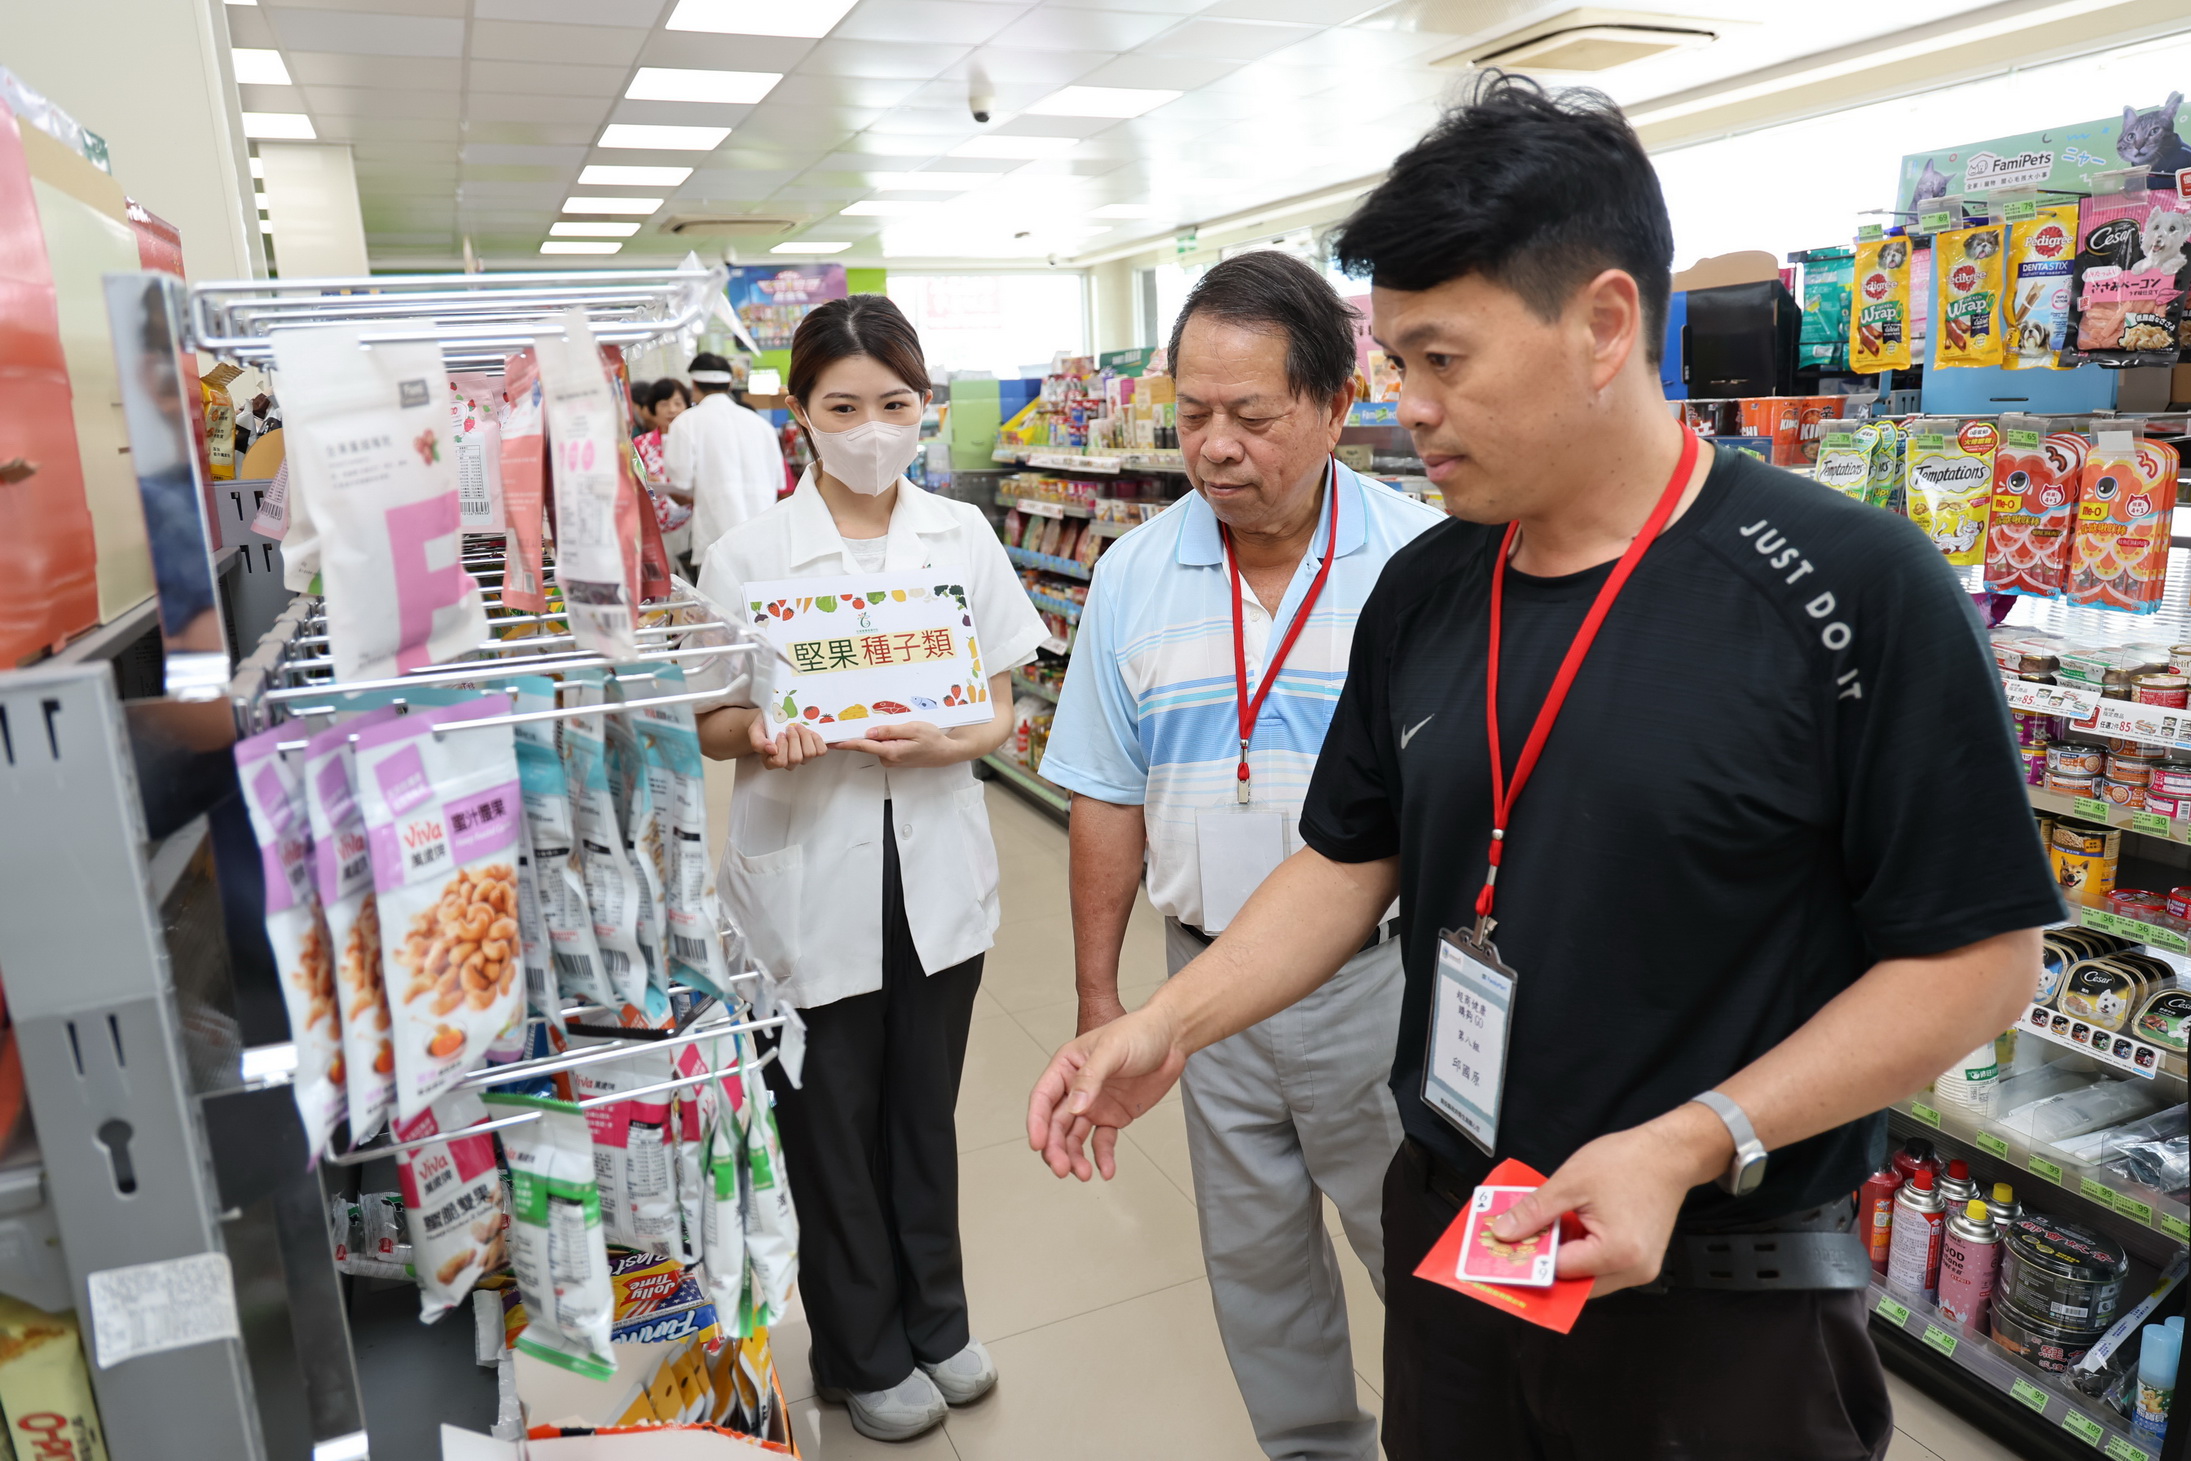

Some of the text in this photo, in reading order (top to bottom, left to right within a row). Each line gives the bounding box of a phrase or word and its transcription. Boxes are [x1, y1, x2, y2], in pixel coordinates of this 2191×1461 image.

[1992, 153, 2051, 172] FamiPets
[2023, 202, 2034, 210] 79
[1938, 213, 1948, 222] 69
[2024, 234, 2074, 249] Pedigree
[2090, 226, 2136, 250] Cesar
[2022, 261, 2068, 272] DENTASTIX
[1947, 272, 1987, 285] edigree
[1861, 280, 1898, 292] edigree
[1948, 299, 1987, 318] Wrap
[1860, 306, 1896, 324] Wrap
[2027, 433, 2037, 441] 65
[1819, 460, 1865, 480] Temptations
[1915, 465, 1985, 486] Temptations
[1995, 499, 2015, 509] Me-O
[2082, 506, 2102, 517] Me-O
[1739, 519, 1862, 700] JUST DO IT
[793, 628, 955, 673] 堅果種子類
[2095, 804, 2105, 812] 45
[2155, 817, 2167, 826] 30
[2103, 914, 2114, 923] 56
[2138, 924, 2149, 933] 56
[2083, 970, 2113, 984] Cesar
[418, 1154, 449, 1180] Viva
[2049, 1165, 2060, 1174] 99
[1479, 1191, 1488, 1202] 6
[2101, 1188, 2112, 1197] 99
[2137, 1204, 2149, 1214] 99
[629, 1274, 674, 1290] Time
[630, 1283, 675, 1300] Jolly
[1896, 1307, 1907, 1317] 60
[1943, 1334, 1955, 1346] 125
[2033, 1391, 2046, 1401] 99
[2087, 1422, 2101, 1434] 109
[2130, 1449, 2146, 1461] 205
